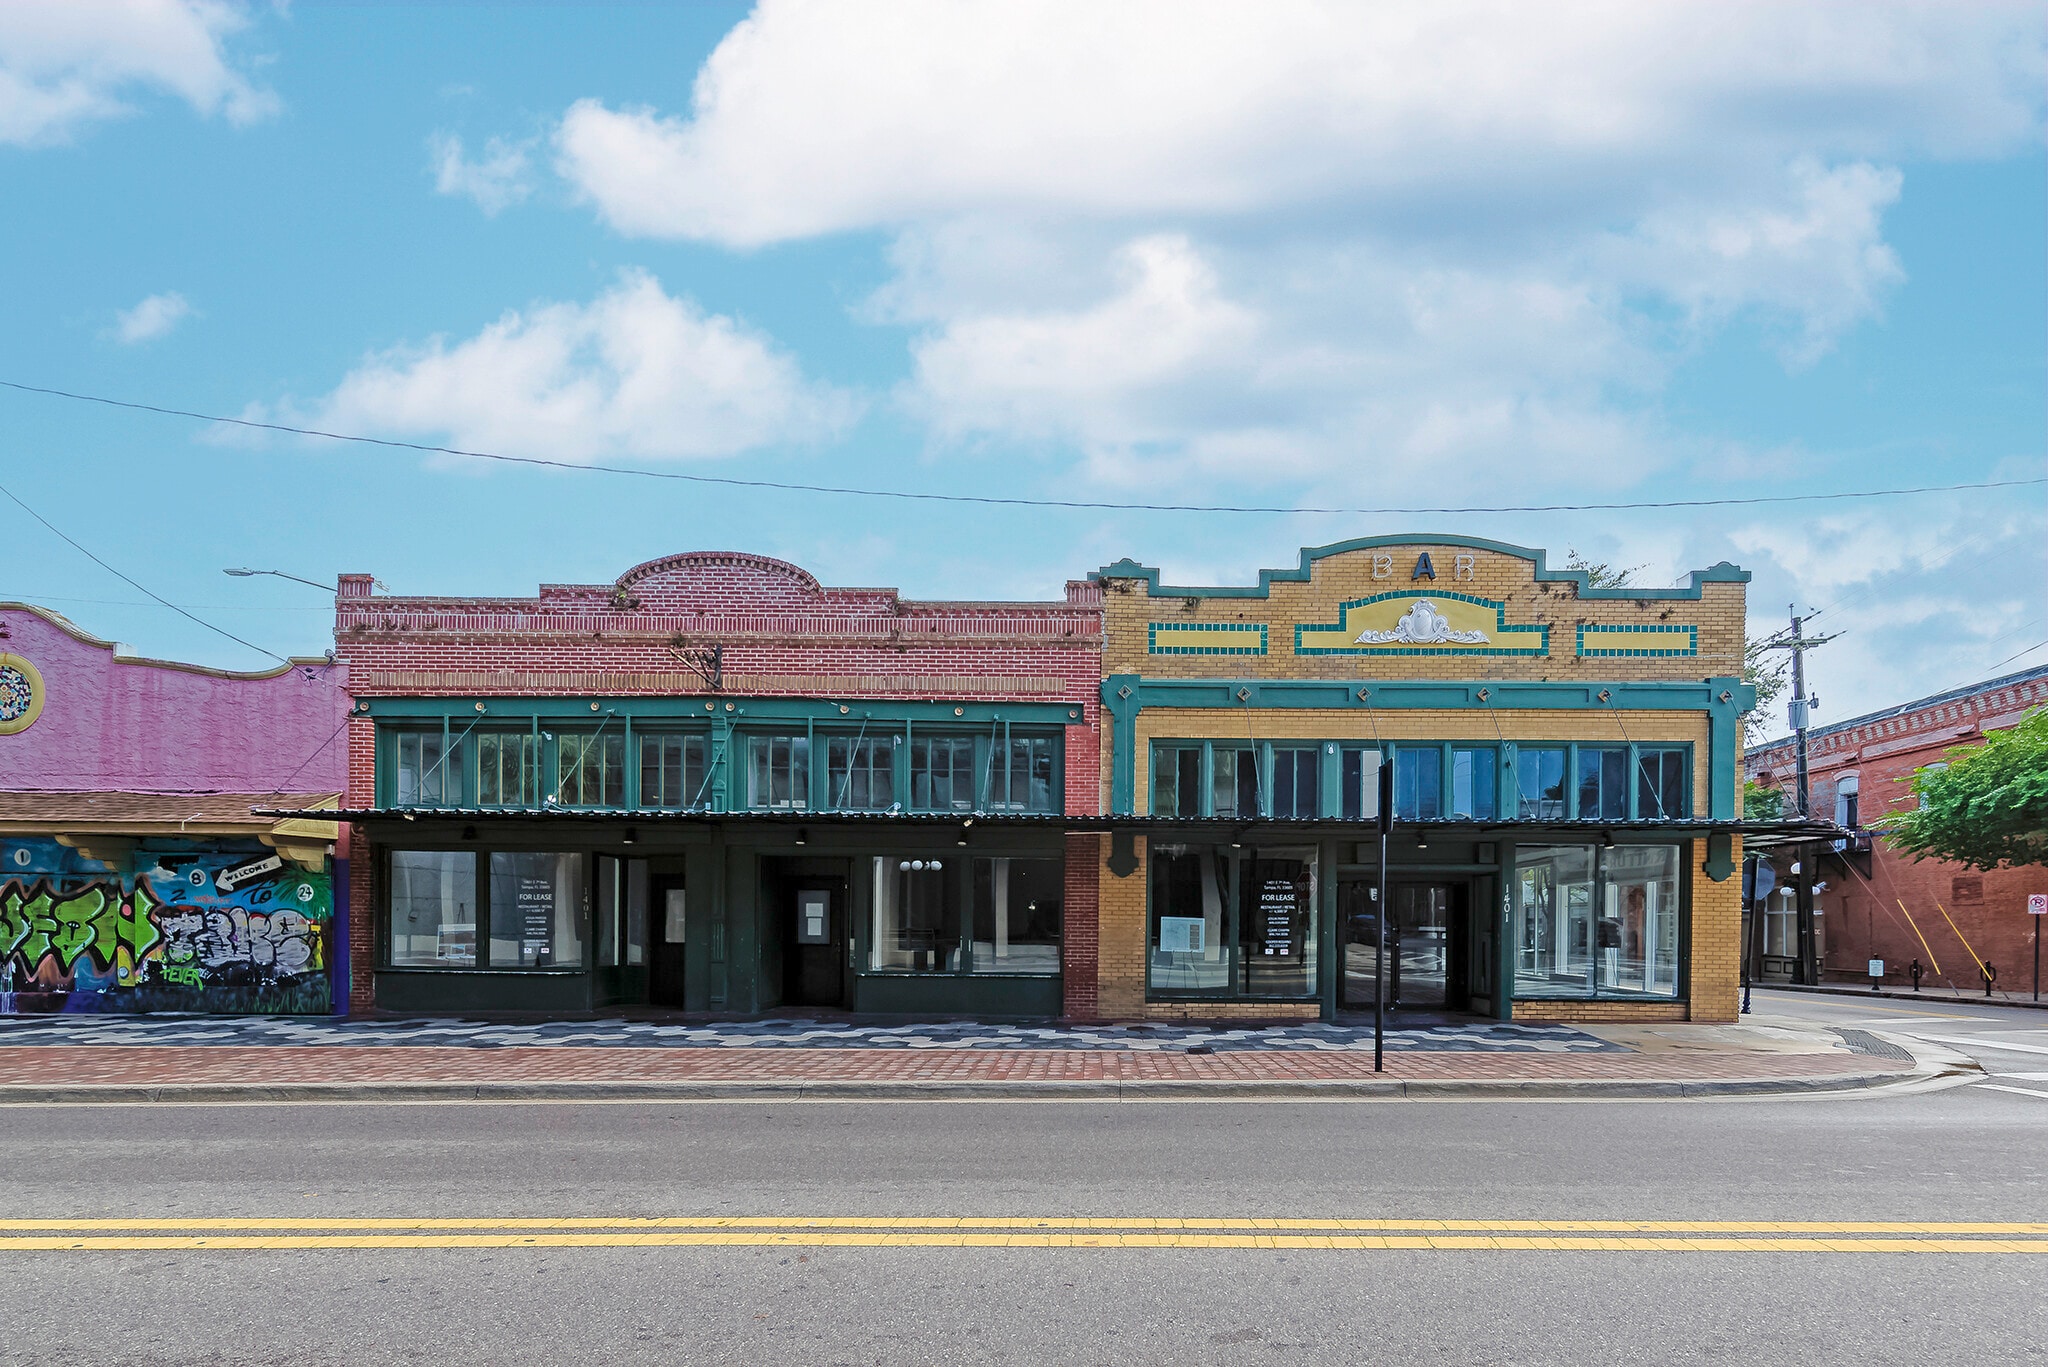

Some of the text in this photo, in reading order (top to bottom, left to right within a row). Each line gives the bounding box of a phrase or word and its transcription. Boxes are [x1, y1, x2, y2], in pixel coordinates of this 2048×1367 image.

[1372, 551, 1475, 581] BAR
[191, 873, 202, 885] 8
[224, 862, 269, 882] WELCOME
[299, 887, 313, 897] 24
